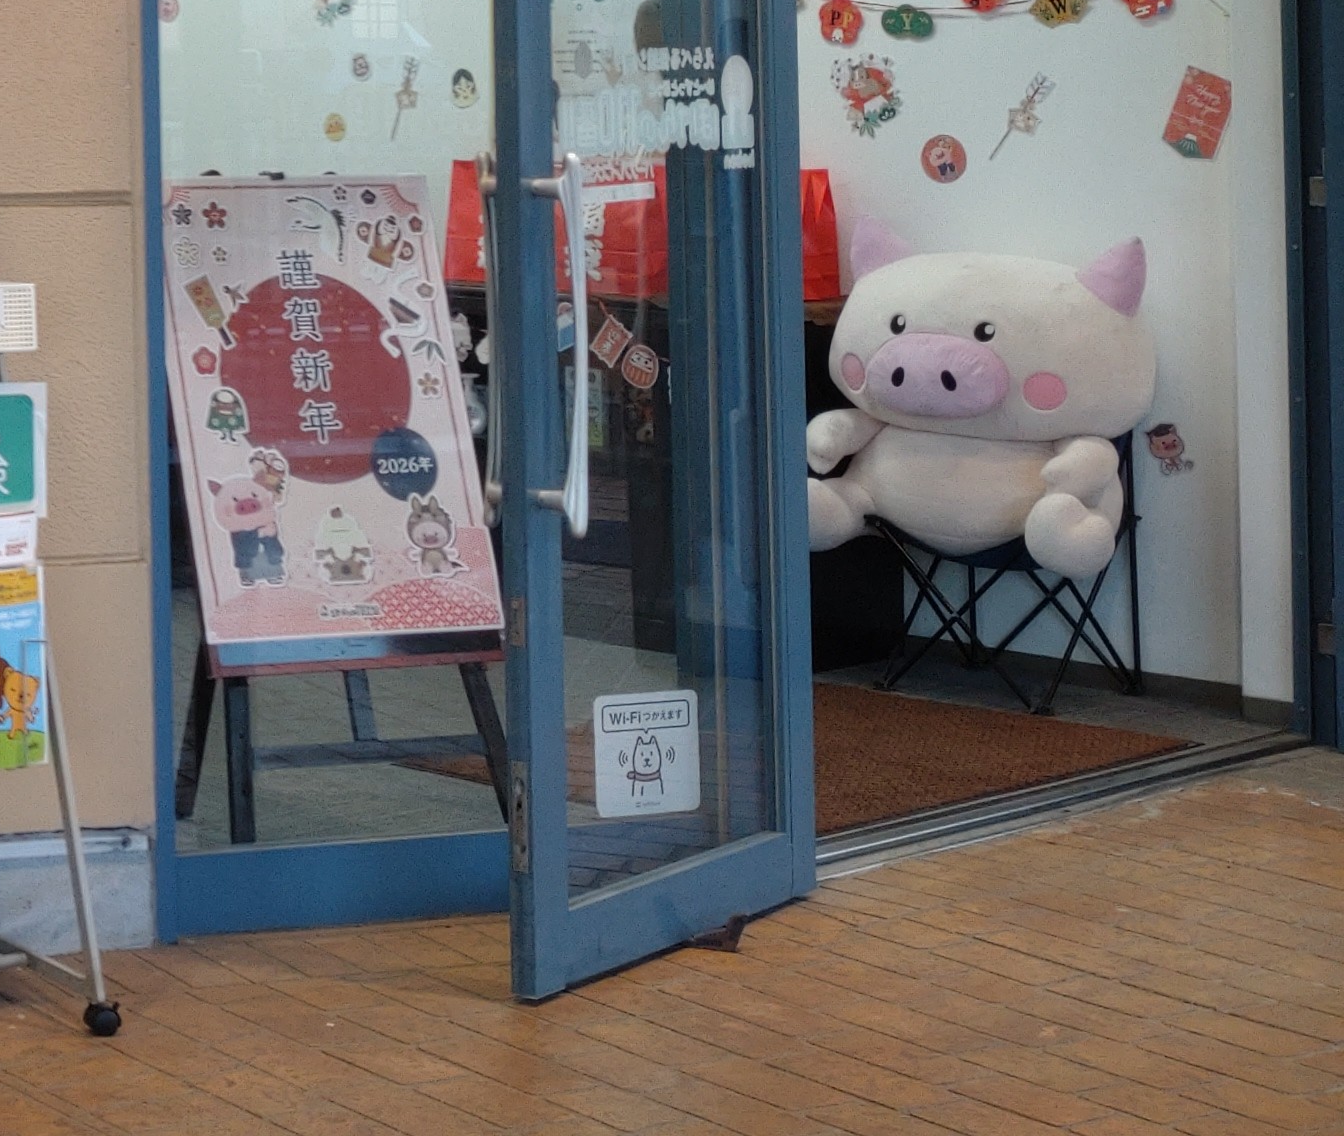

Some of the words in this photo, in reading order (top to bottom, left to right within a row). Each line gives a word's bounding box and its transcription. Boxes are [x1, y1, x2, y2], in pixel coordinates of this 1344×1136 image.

[275, 248, 343, 445] 謹賀新年
[377, 457, 435, 475] 2026年
[609, 710, 642, 726] Wi-Fi
[643, 709, 684, 722] つかえます
